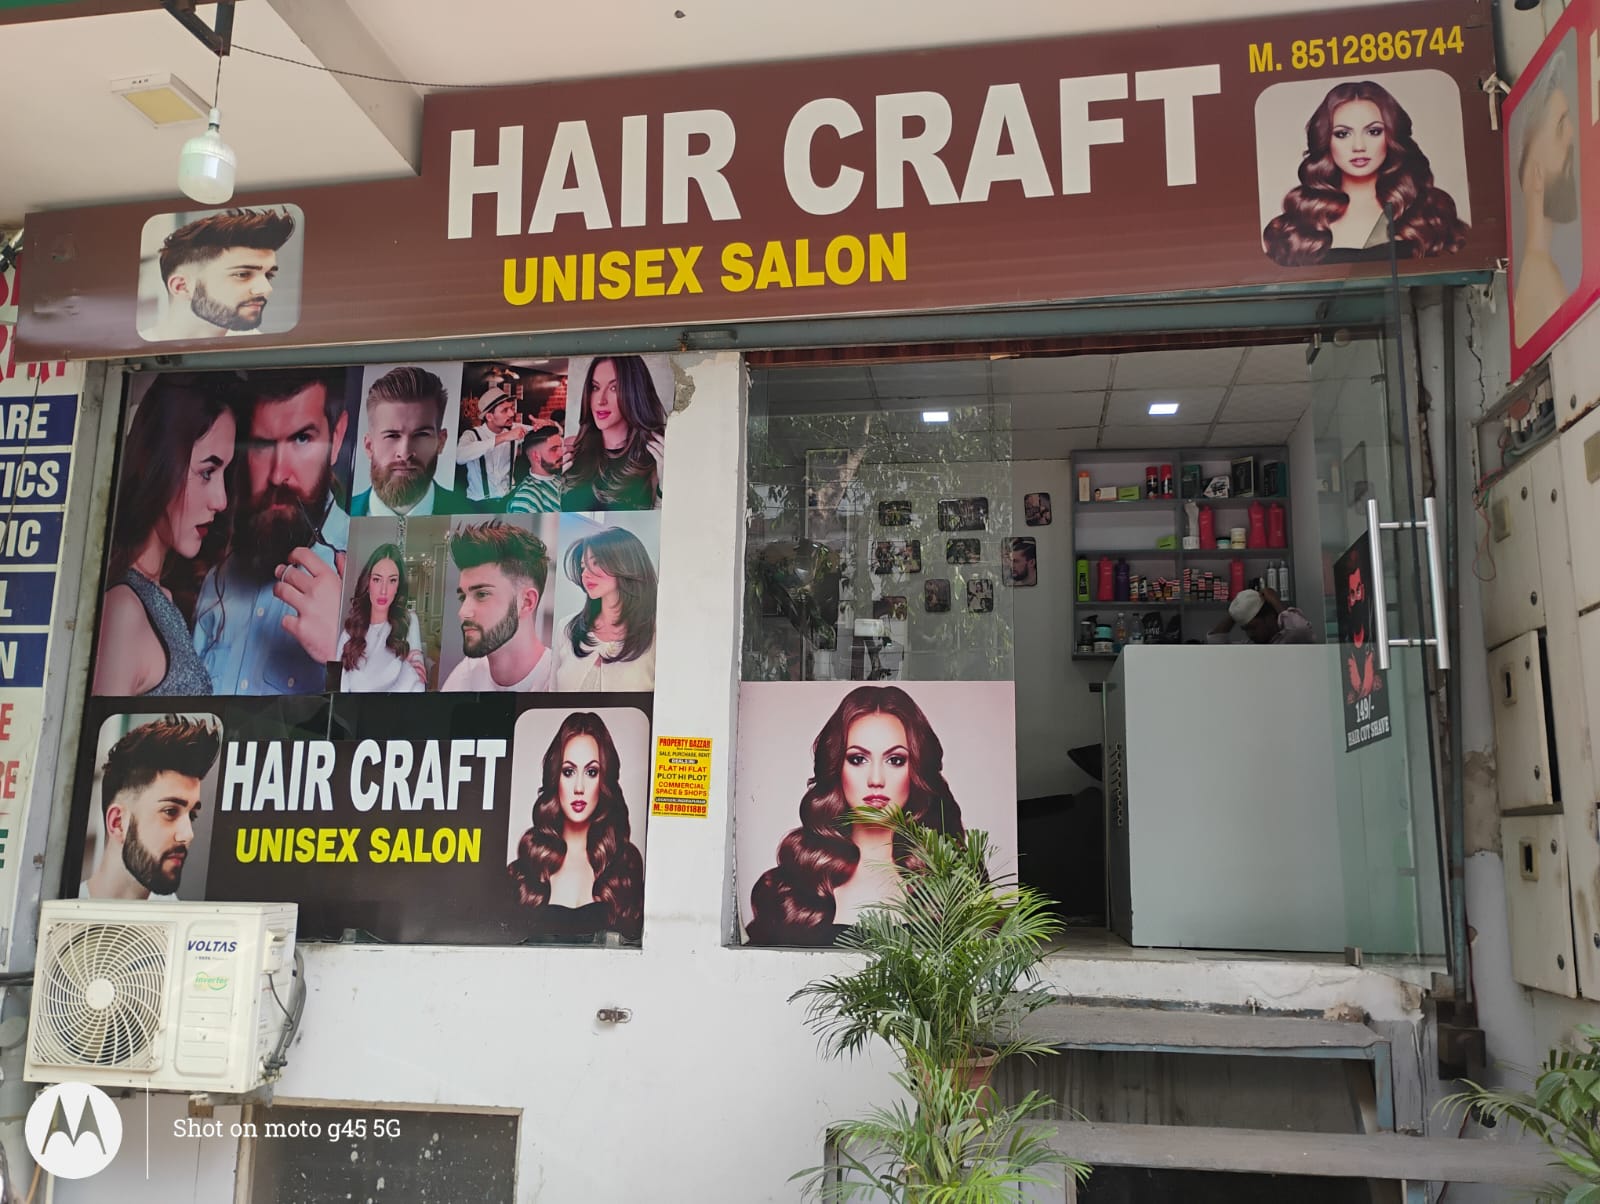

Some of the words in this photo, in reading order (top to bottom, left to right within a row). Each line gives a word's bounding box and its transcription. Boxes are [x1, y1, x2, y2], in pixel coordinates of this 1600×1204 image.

[1249, 42, 1282, 73] M.
[1291, 25, 1464, 69] 8512886744
[448, 108, 742, 239] HAIR
[783, 64, 1221, 215] CRAFT
[503, 246, 703, 305] UNISEX
[721, 231, 907, 292] SALON
[659, 738, 688, 747] PROPERTY
[1347, 729, 1360, 746] HAIR
[1361, 723, 1370, 741] CUT
[1371, 716, 1389, 737] SHAVE
[221, 741, 336, 812] HAIR
[350, 739, 507, 812] CRAFT
[235, 828, 361, 863] UNISEX
[369, 828, 481, 863] SALON
[187, 940, 237, 952] VOLTAS
